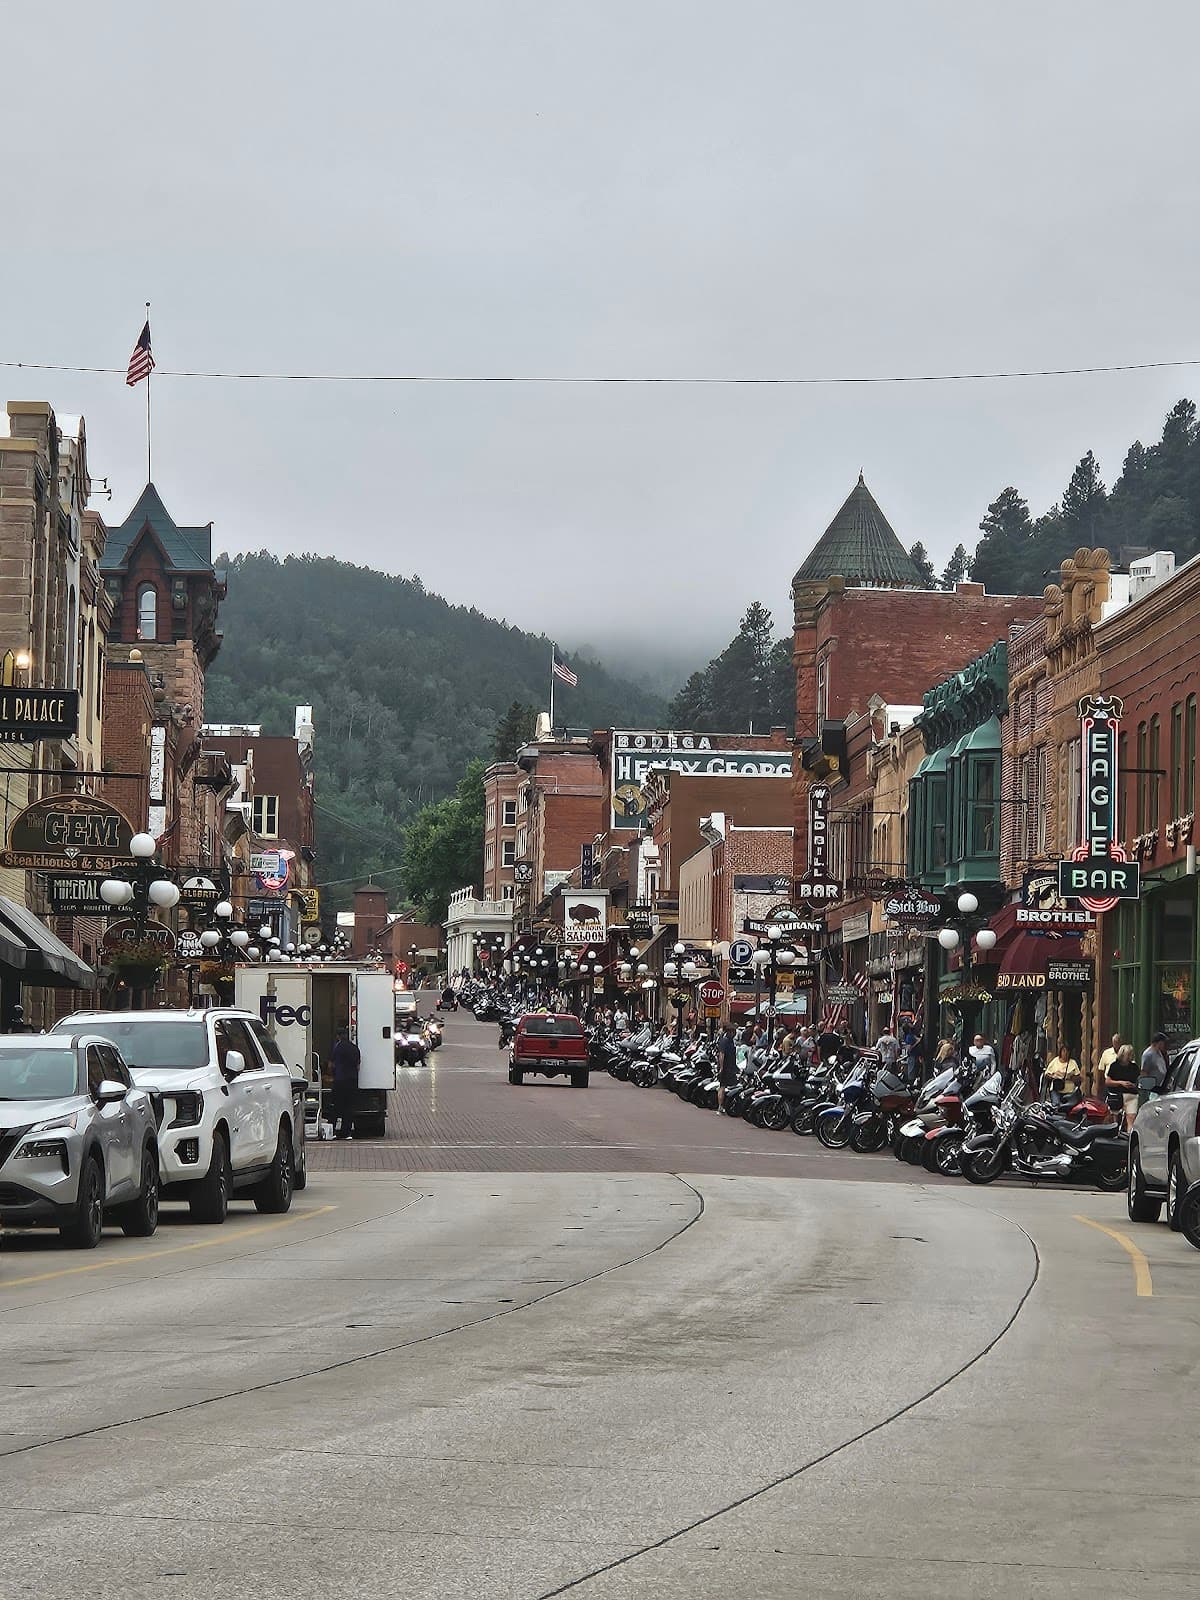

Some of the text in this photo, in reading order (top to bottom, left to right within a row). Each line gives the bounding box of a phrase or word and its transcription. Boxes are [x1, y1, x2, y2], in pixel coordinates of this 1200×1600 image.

[15, 697, 65, 722] PALACE
[617, 735, 711, 750] BODEGA
[1091, 733, 1109, 857] EAGLE
[44, 811, 121, 848] GEM
[4, 853, 78, 868] Steakhouse
[81, 857, 92, 869] &
[1071, 869, 1128, 890] BAR
[53, 879, 99, 900] MINERAL
[800, 884, 839, 898] BAR
[886, 898, 941, 917] Sick Boy
[1016, 909, 1096, 923] BROTHEL
[566, 931, 604, 941] SALOON
[1012, 973, 1046, 987] LAND
[1048, 971, 1091, 981] BROTHEL
[701, 987, 724, 999] STOP
